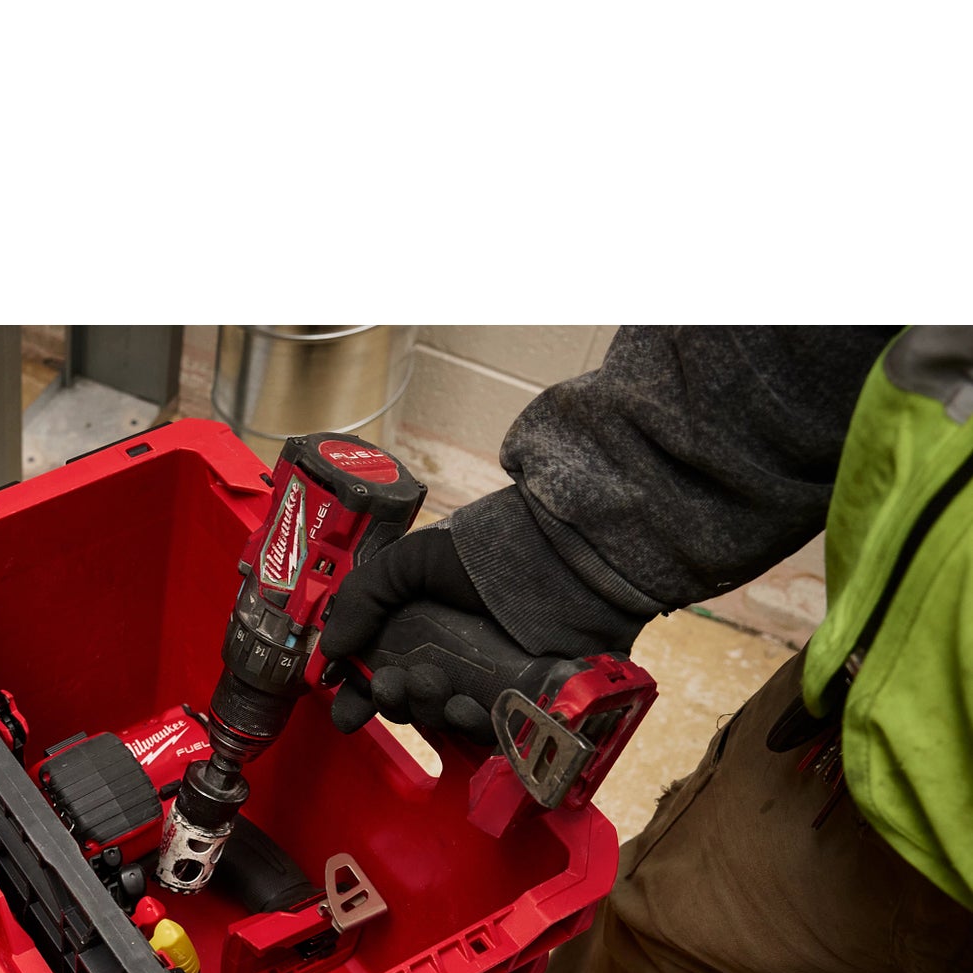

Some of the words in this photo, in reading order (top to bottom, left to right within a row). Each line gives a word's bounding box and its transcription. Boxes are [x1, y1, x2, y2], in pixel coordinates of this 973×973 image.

[329, 450, 384, 460] FUEL
[309, 501, 331, 540] FUEL
[262, 482, 299, 583] Milwaukee
[254, 645, 266, 657] 14
[280, 656, 292, 668] 12
[176, 741, 211, 757] FUEL
